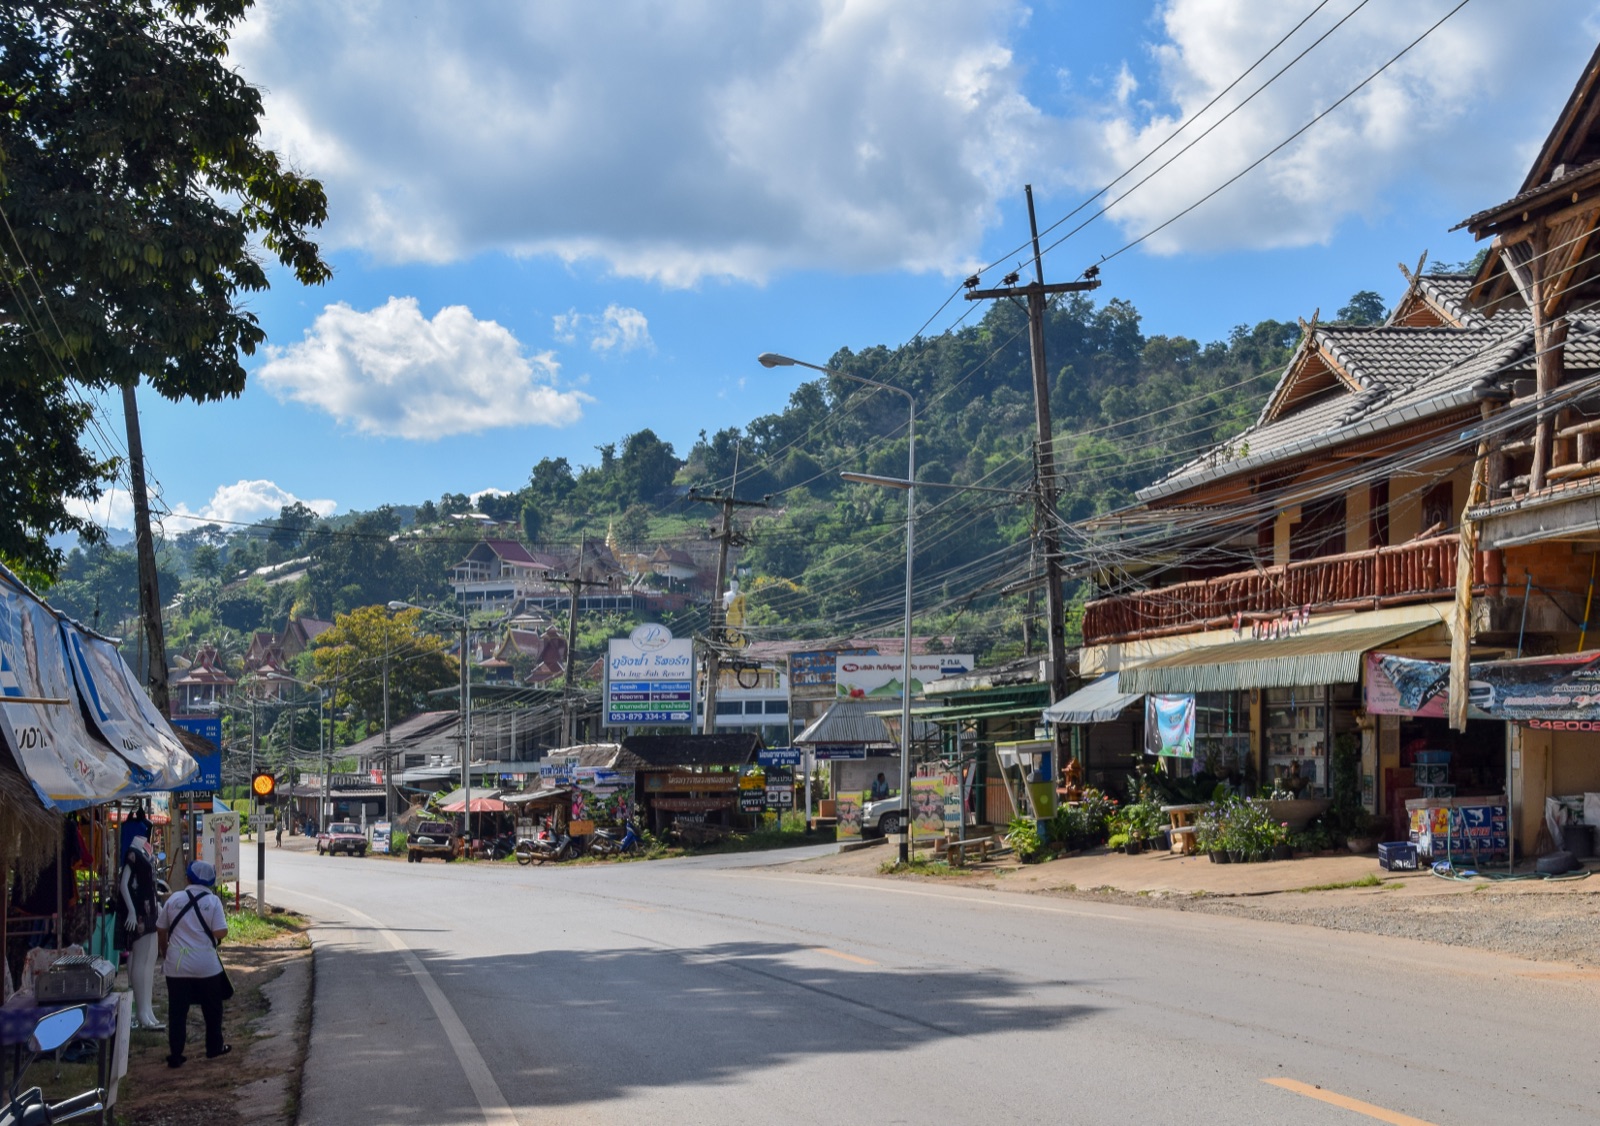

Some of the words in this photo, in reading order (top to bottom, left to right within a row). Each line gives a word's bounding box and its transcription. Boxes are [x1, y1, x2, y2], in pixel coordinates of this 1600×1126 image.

[612, 653, 648, 669] ภูอิงฟ้า
[629, 670, 641, 678] Ing
[643, 669, 659, 677] Fah
